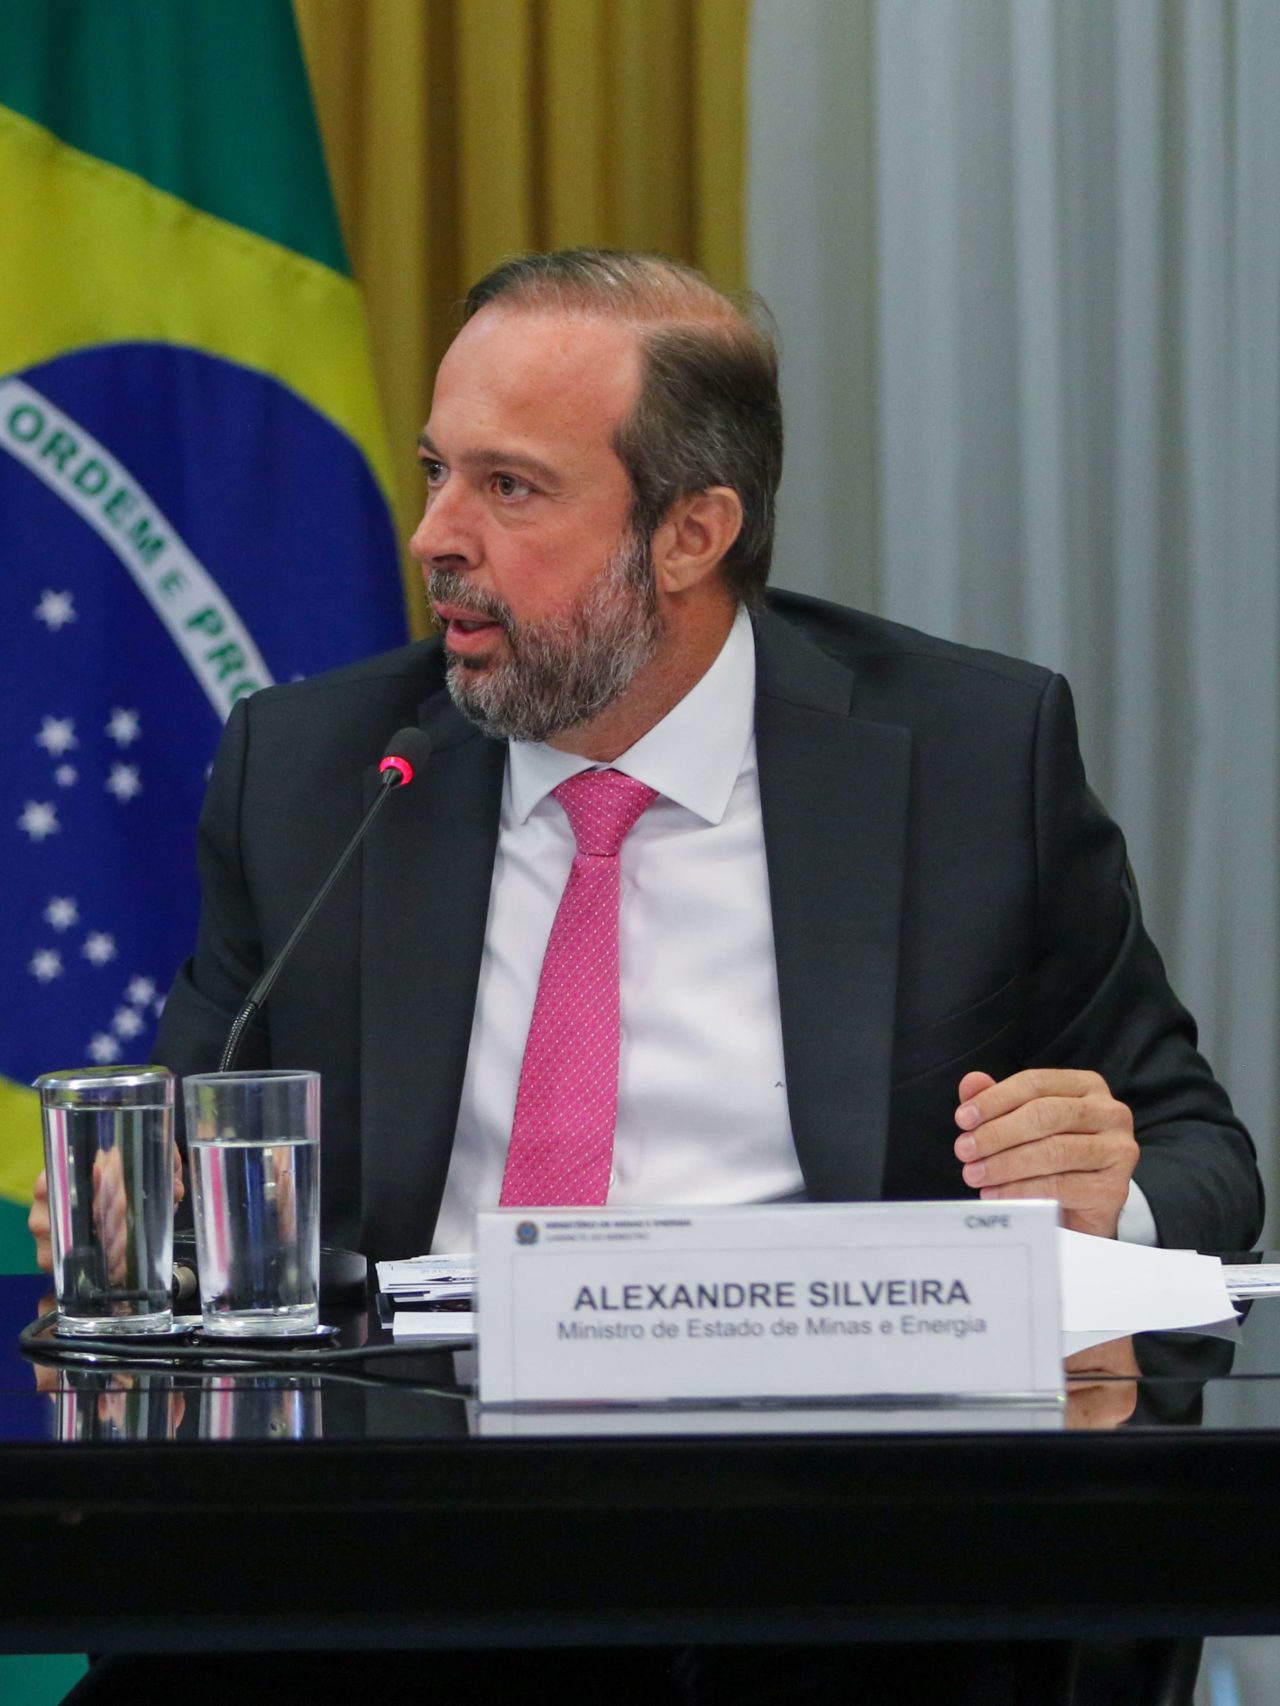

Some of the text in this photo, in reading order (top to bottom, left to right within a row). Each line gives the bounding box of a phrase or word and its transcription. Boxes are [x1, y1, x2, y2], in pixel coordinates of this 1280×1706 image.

[7, 404, 165, 566] ORDEM
[964, 1214, 1011, 1229] CNPE
[573, 1279, 971, 1311] ALEXANDRE SILVEIRA
[557, 1313, 987, 1340] Ministro de Estado de Minas e Energia
